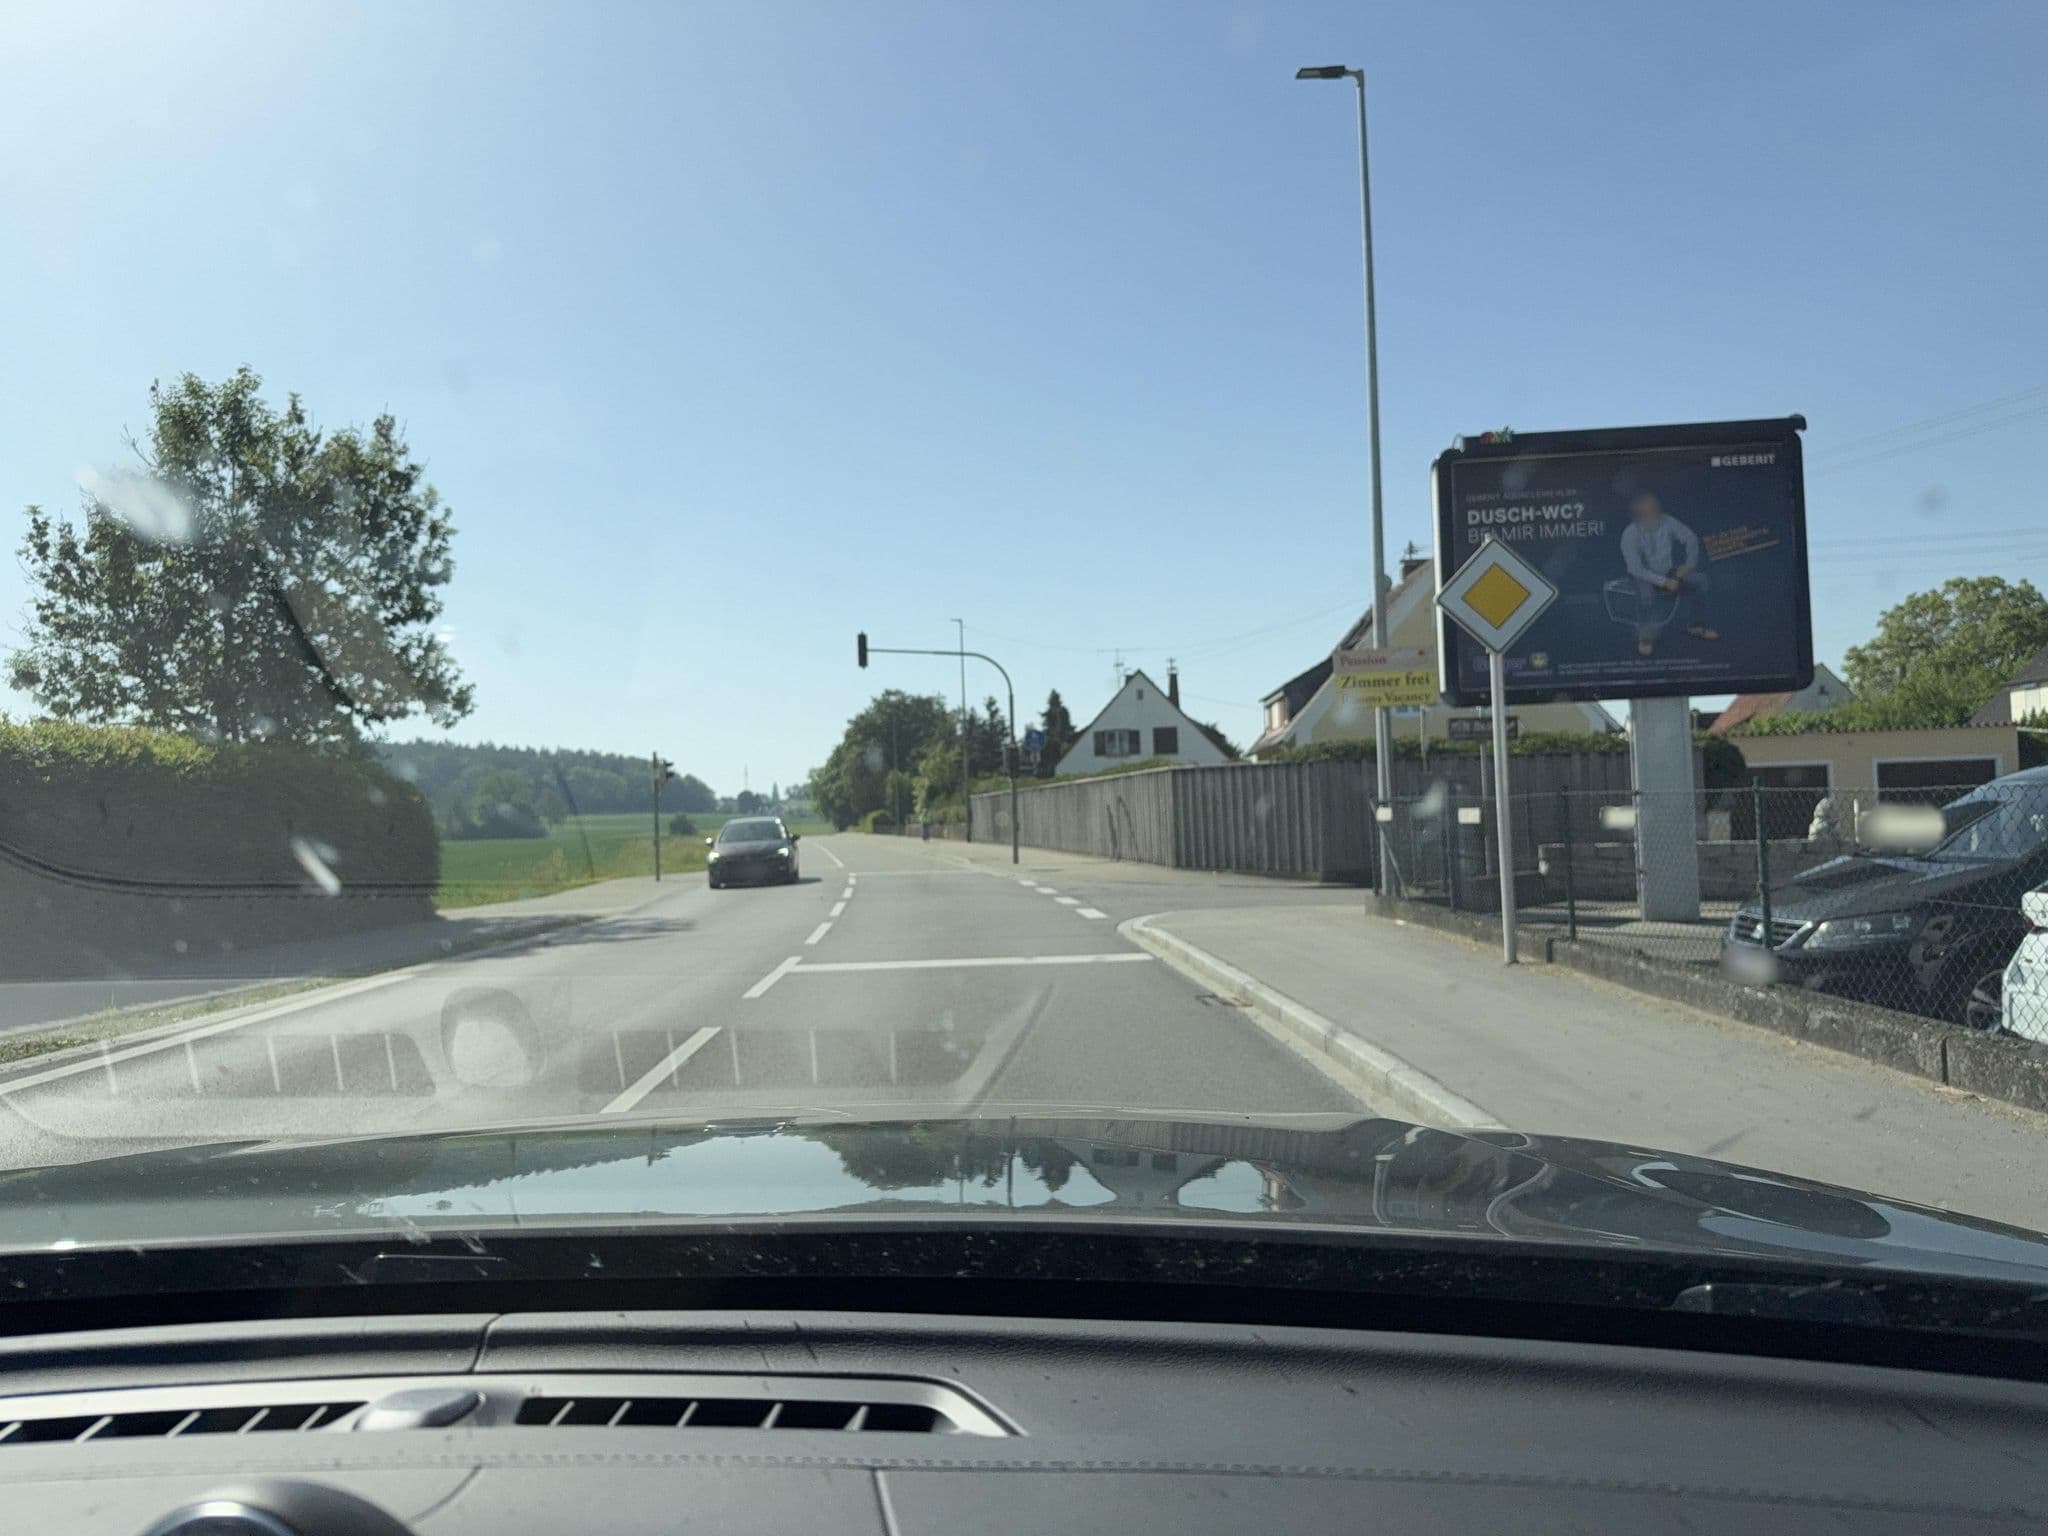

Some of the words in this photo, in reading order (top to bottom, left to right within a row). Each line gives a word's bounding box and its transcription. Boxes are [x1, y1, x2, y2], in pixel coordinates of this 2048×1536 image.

[1721, 454, 1776, 467] GEBERIT
[1466, 503, 1585, 525] DUSCH-WC?
[1501, 523, 1534, 542] MIR
[1538, 520, 1605, 540] IMMER!
[1339, 675, 1402, 689] Zimmer
[1405, 671, 1430, 687] frei
